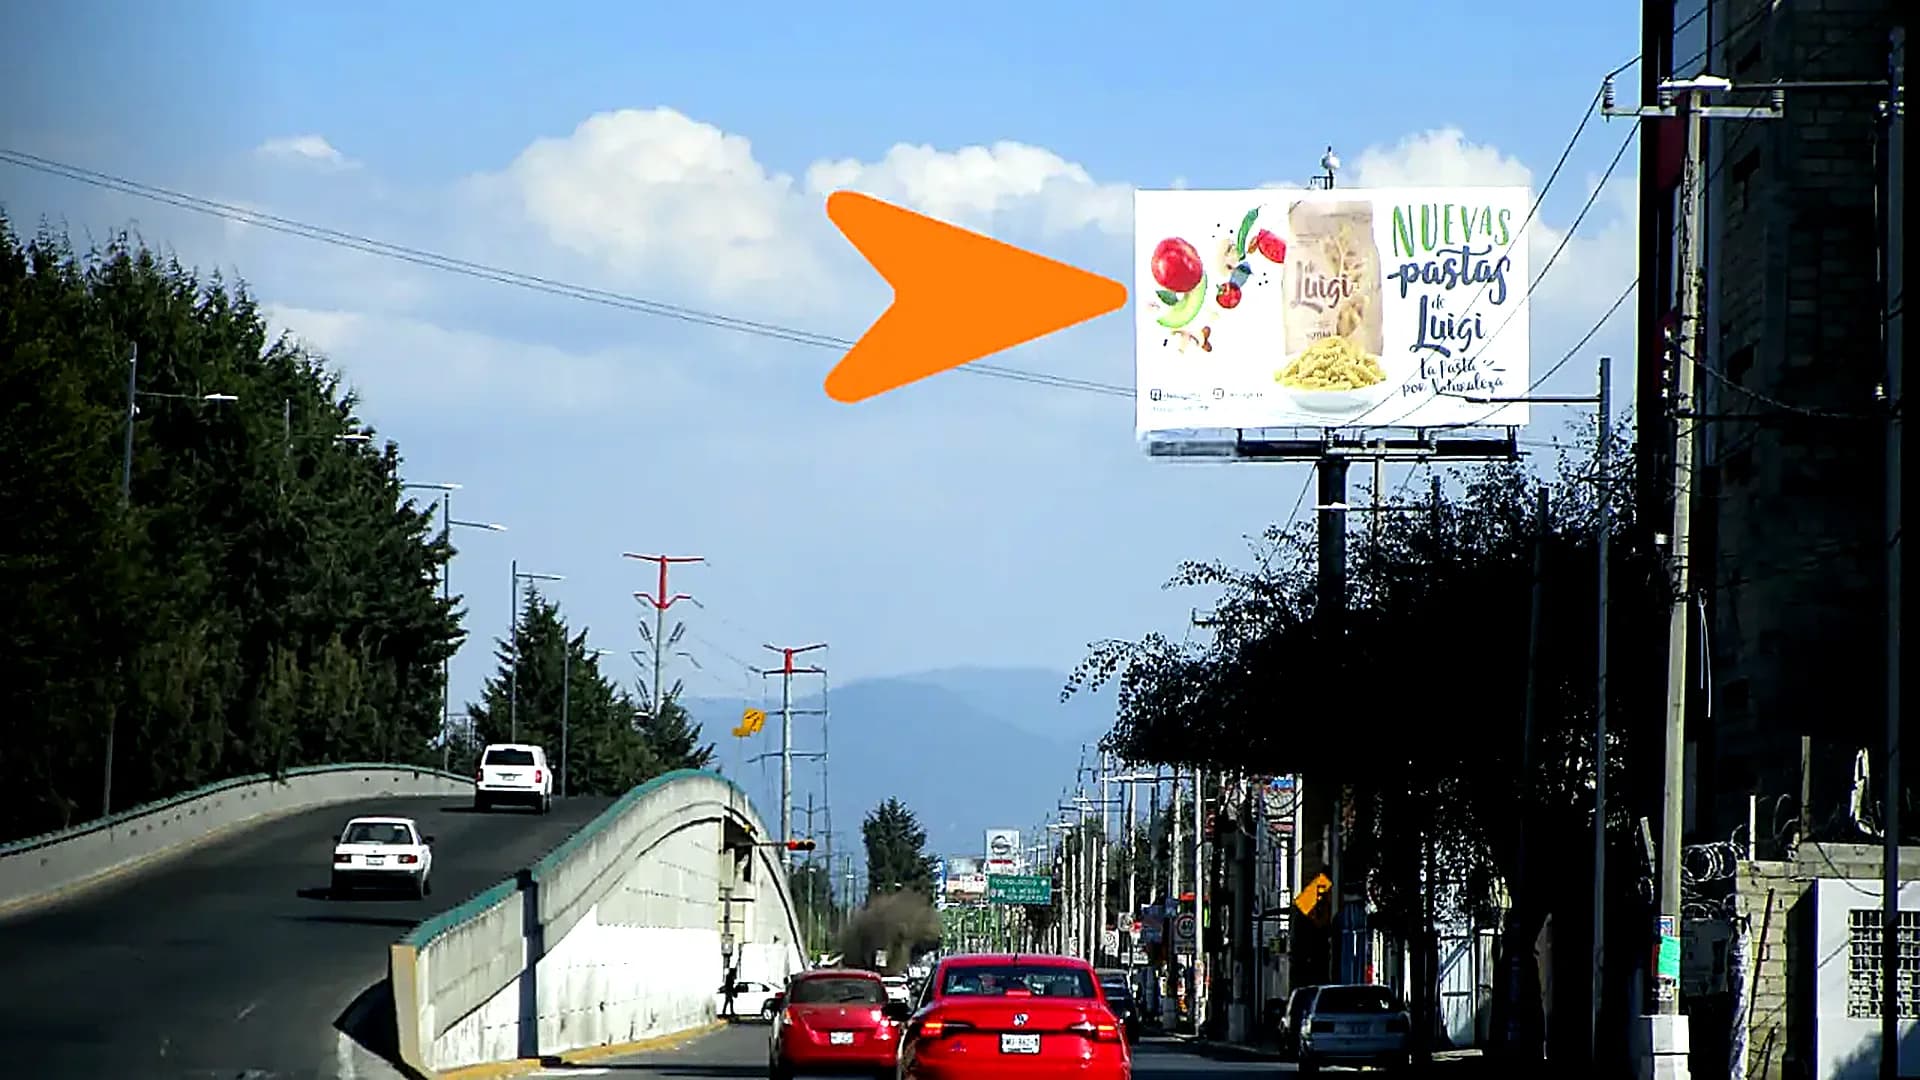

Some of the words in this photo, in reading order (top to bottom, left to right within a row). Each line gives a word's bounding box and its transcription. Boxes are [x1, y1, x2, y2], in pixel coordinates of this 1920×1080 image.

[1393, 203, 1510, 258] NUEVAS
[1290, 261, 1353, 314] Luigi
[1387, 245, 1511, 305] pastas
[1409, 294, 1486, 358] Luigi
